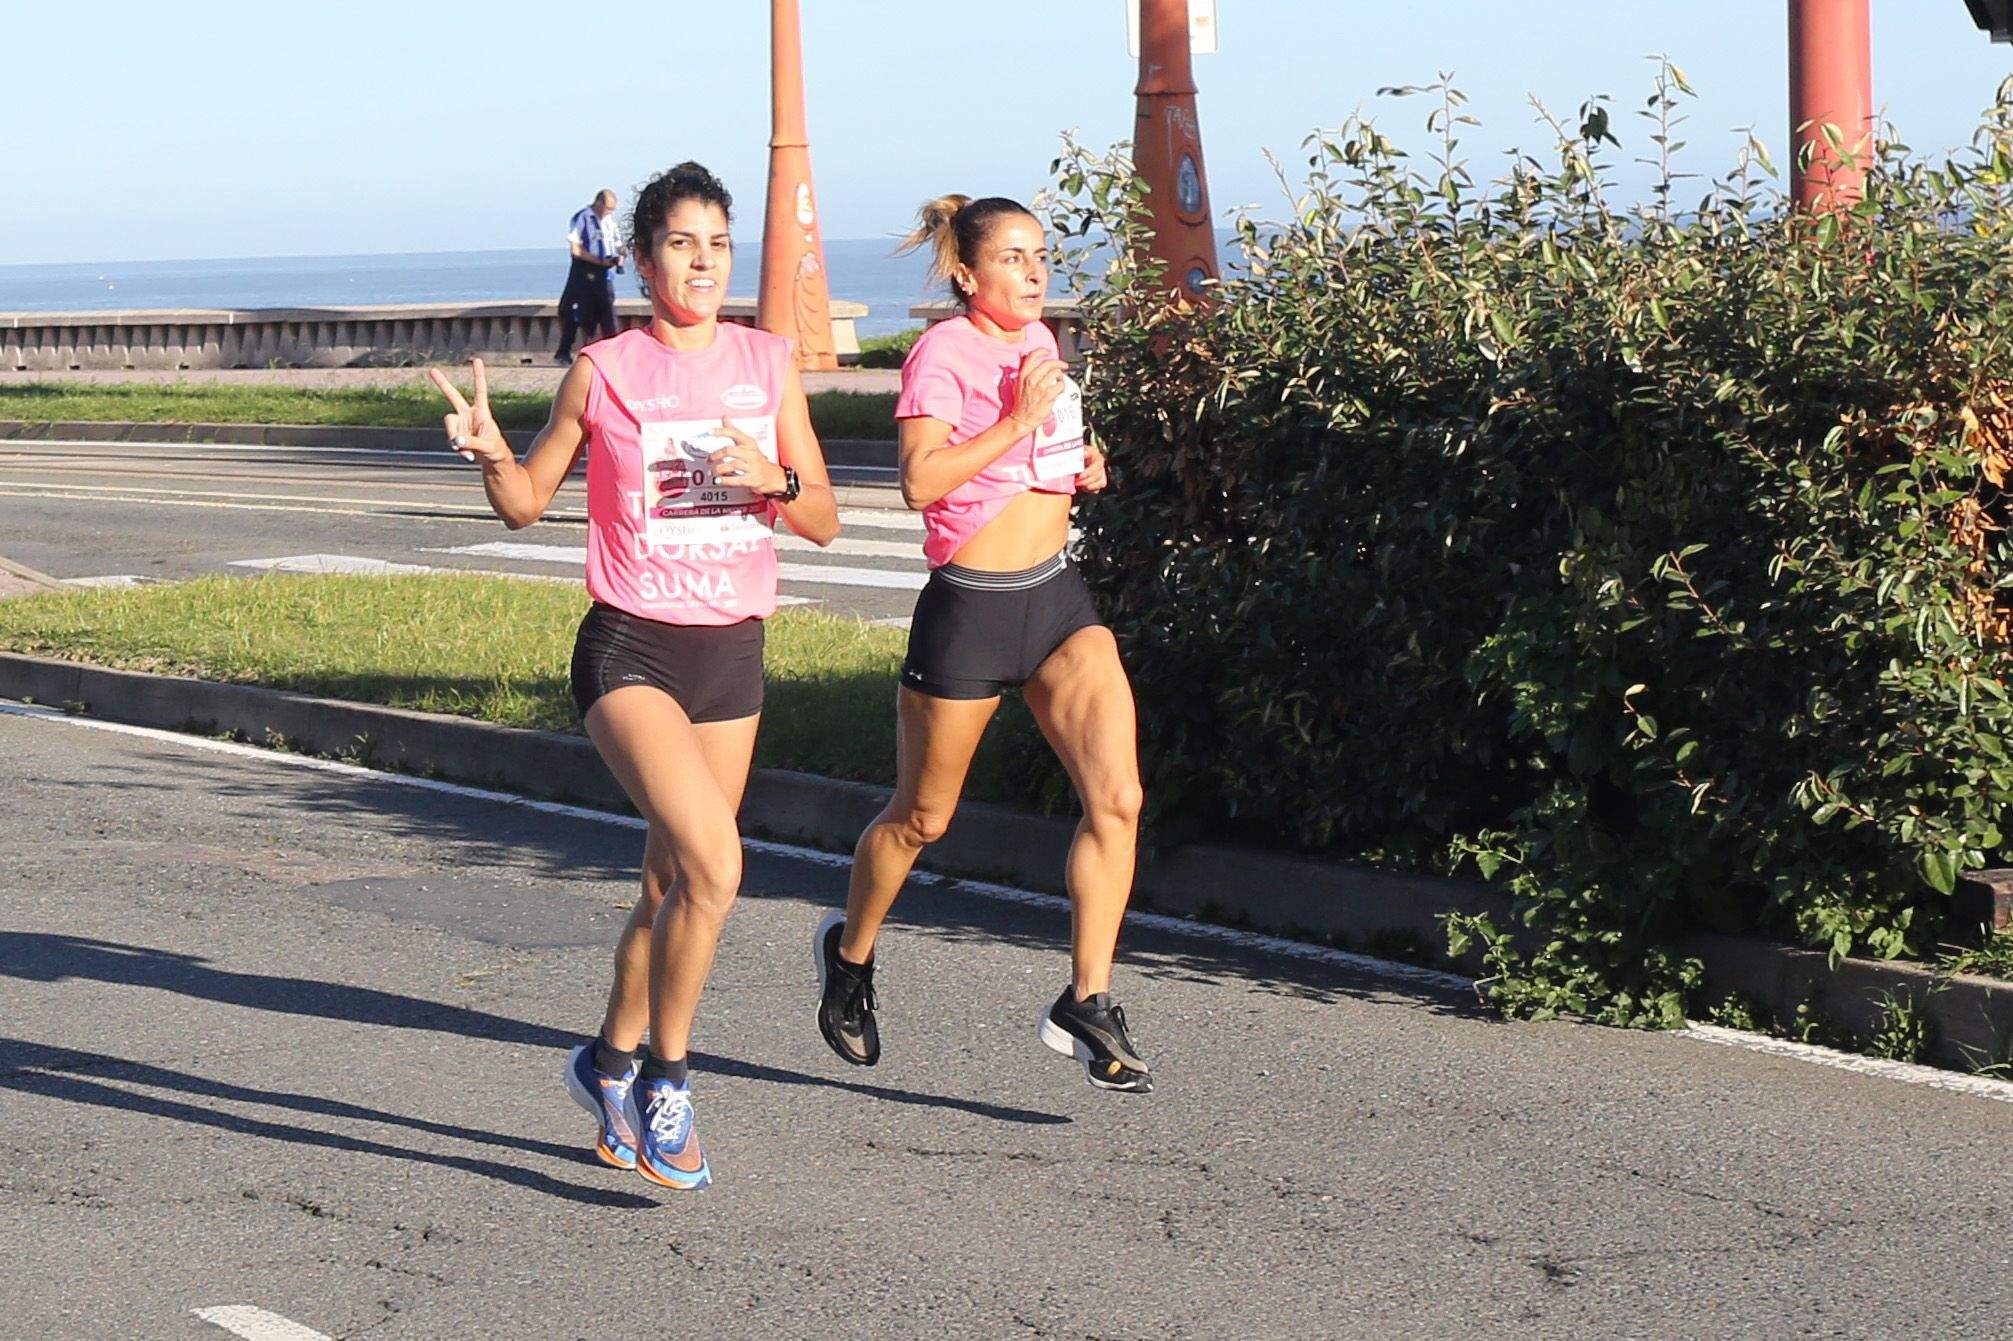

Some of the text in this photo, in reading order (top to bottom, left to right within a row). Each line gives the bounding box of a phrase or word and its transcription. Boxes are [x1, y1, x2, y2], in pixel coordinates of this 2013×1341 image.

[701, 491, 728, 502] 4015
[700, 507, 710, 515] DE
[711, 506, 721, 515] LA
[640, 569, 736, 600] SUMA
